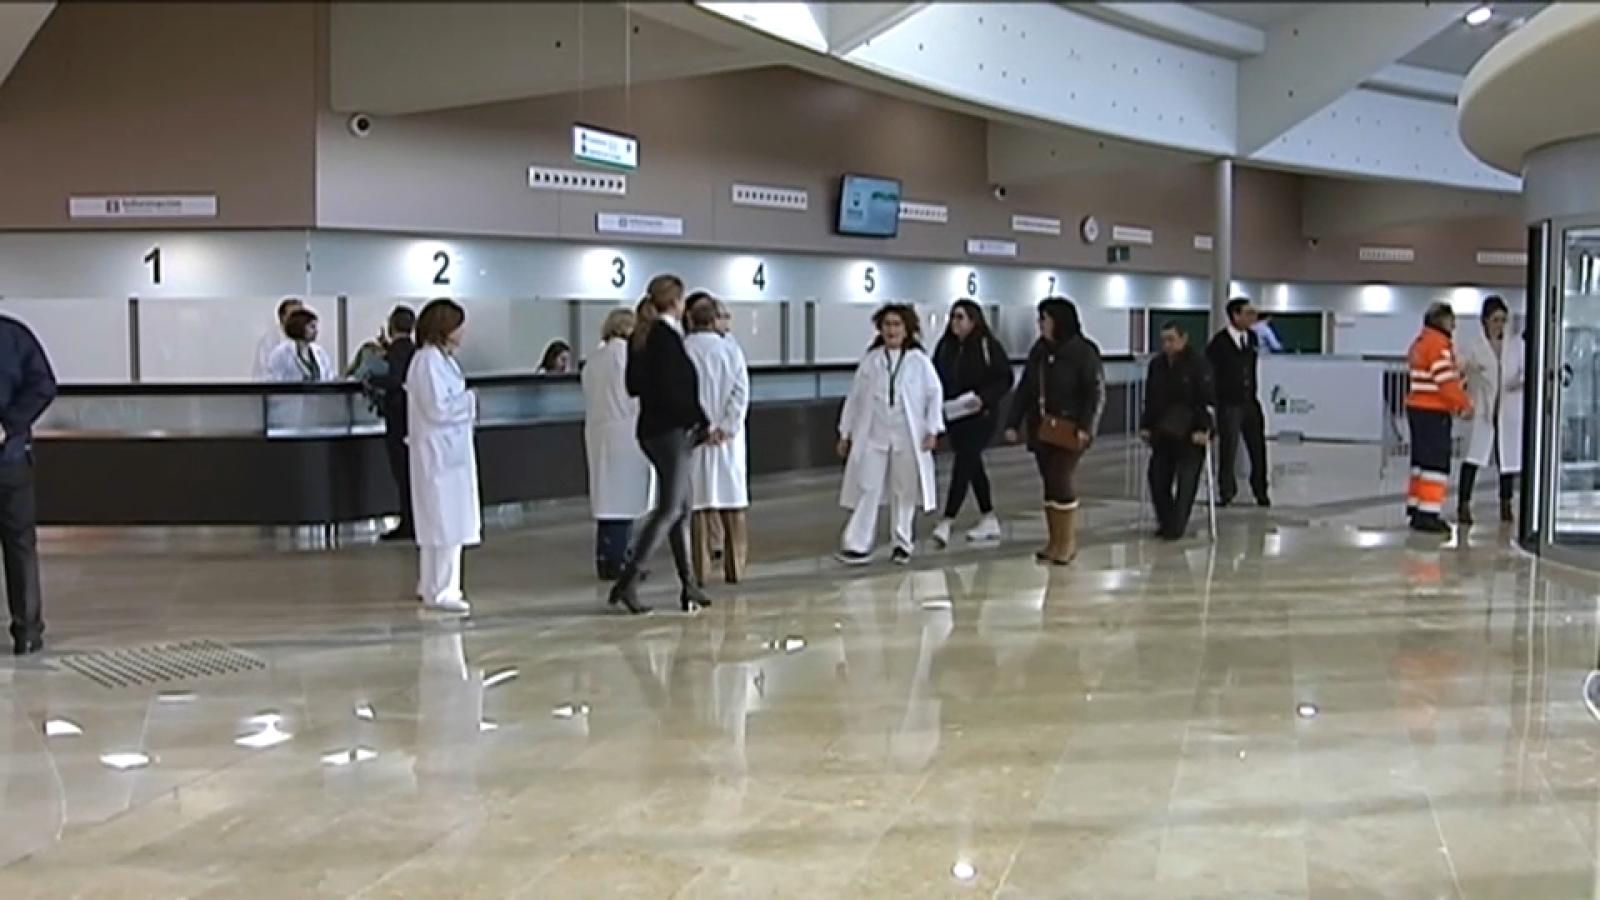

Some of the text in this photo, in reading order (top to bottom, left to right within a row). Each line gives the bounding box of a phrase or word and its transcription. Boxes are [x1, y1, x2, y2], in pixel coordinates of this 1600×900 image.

[144, 248, 161, 284] 1
[432, 250, 450, 285] 2
[611, 257, 626, 288] 3
[752, 262, 766, 291] 4
[864, 267, 876, 293] 5
[967, 272, 977, 296] 6
[1047, 276, 1056, 297] 7
